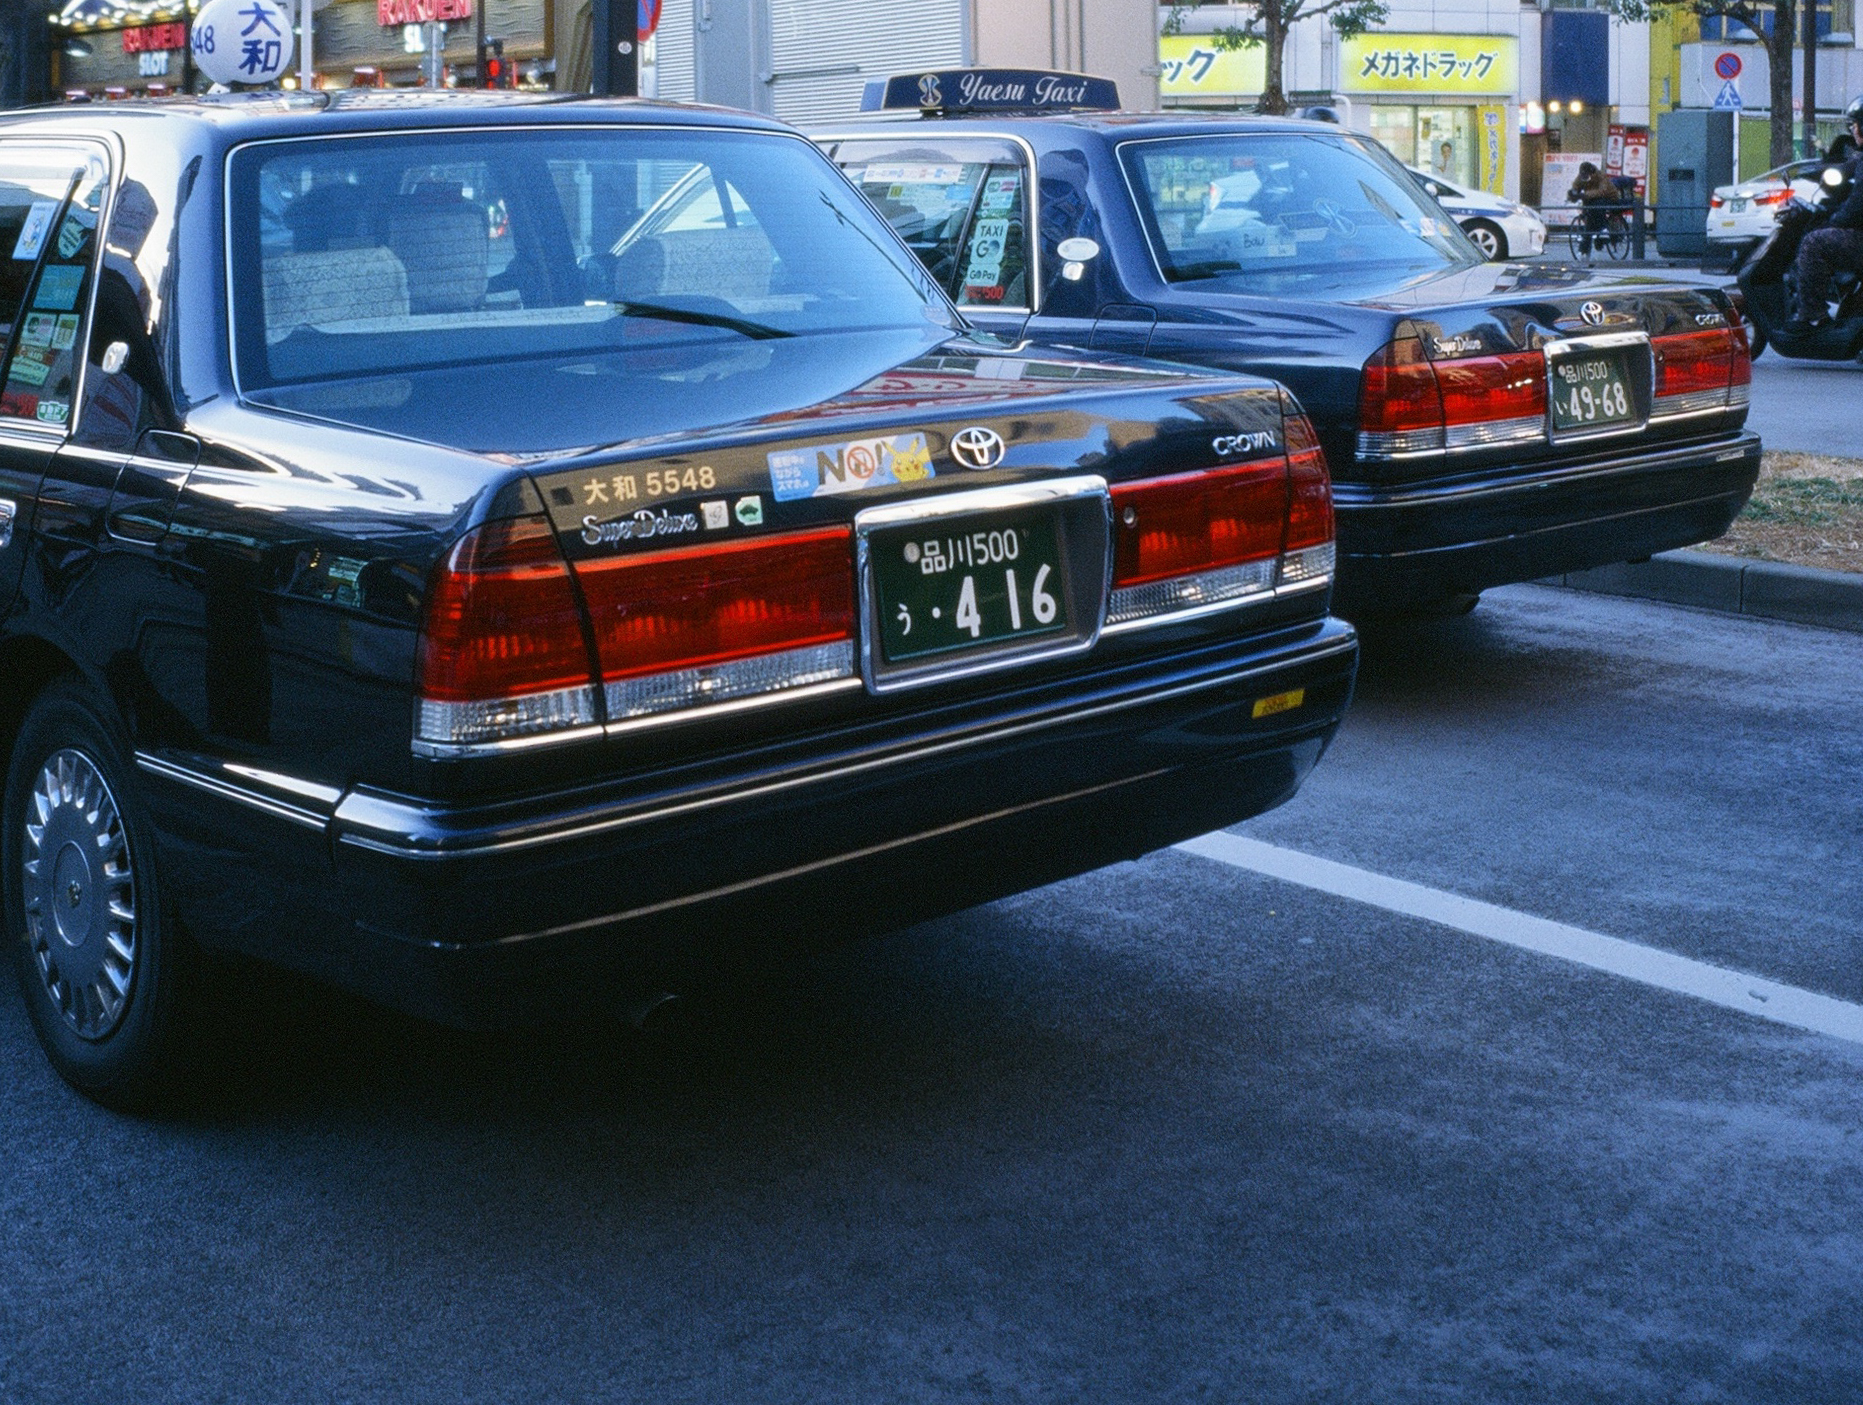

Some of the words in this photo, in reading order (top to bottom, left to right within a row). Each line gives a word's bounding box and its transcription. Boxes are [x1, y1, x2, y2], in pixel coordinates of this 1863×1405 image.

[238, 1, 282, 75] 大和
[1360, 51, 1499, 81] メガネドラッグ
[959, 73, 1025, 107] Yaesu
[1033, 74, 1089, 106] Taxi
[980, 225, 1004, 238] TAXI
[1569, 381, 1628, 422] 49-68
[1211, 429, 1276, 458] CROWN
[583, 473, 638, 507] 大和
[645, 466, 717, 496] 5548
[581, 514, 637, 546] Super
[633, 509, 699, 539] Deluxe
[896, 607, 915, 637] う
